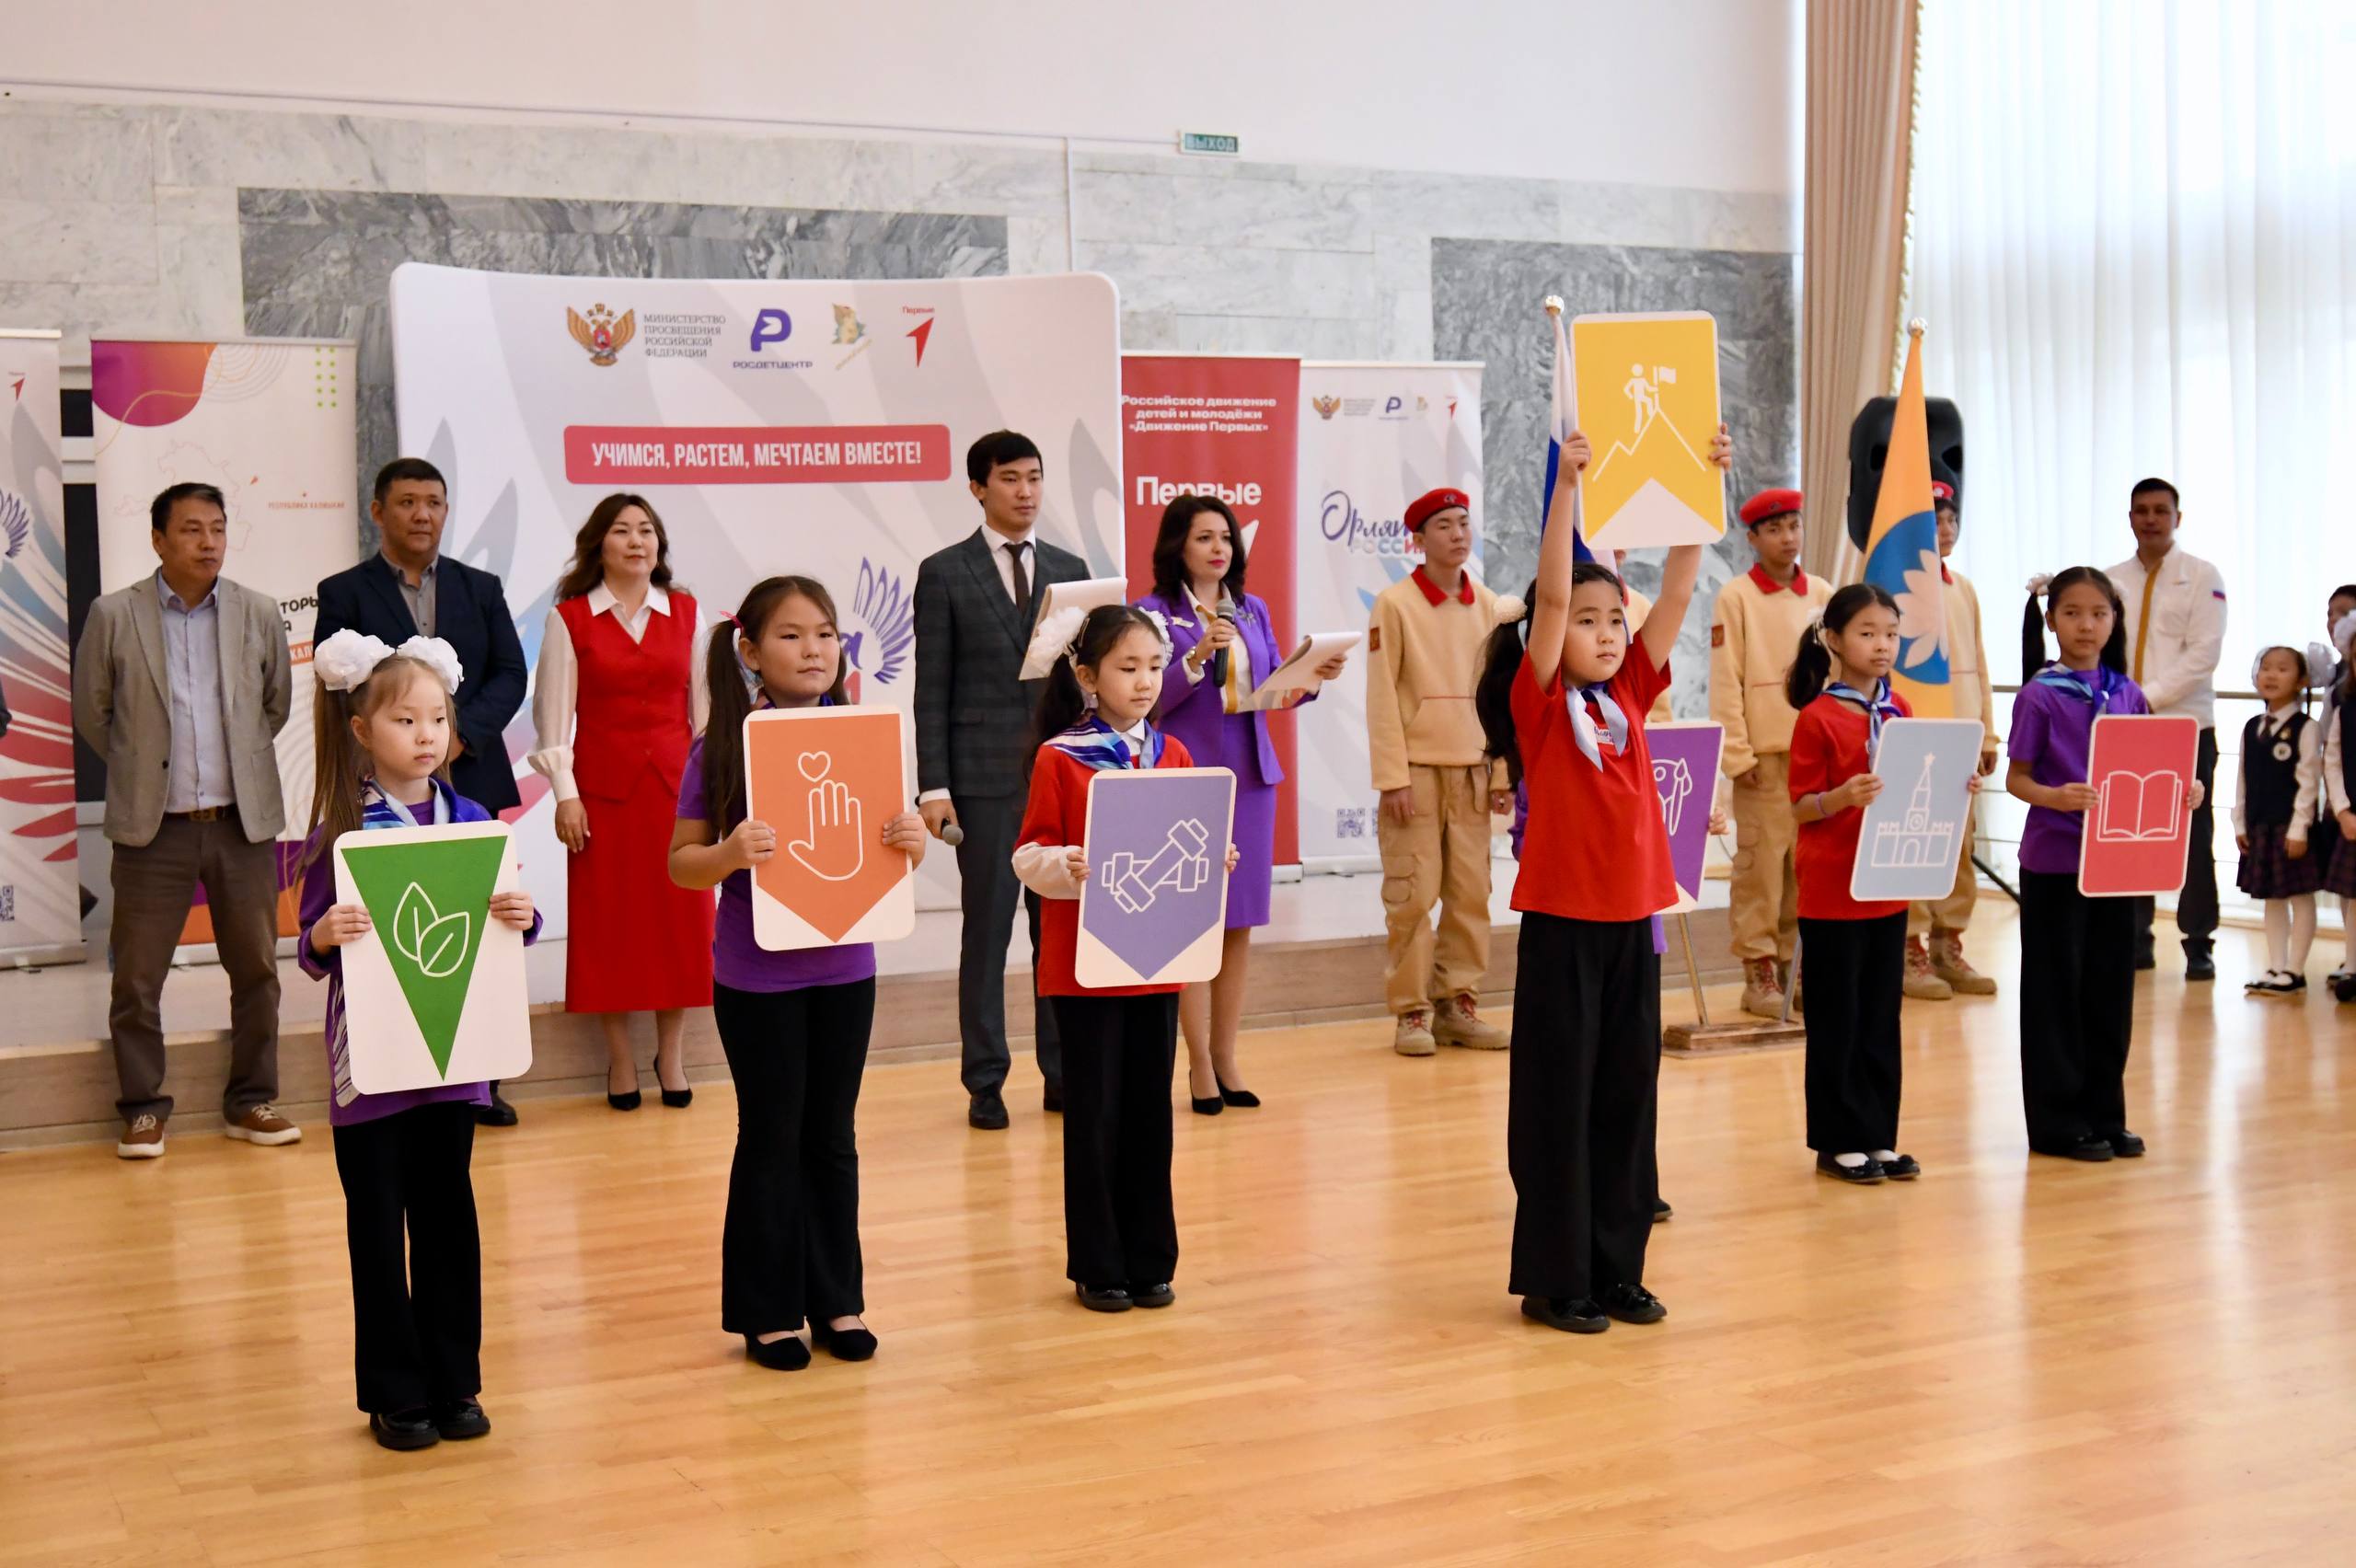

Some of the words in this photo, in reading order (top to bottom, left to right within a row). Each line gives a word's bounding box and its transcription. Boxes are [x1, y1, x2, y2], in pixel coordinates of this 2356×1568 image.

[1186, 134, 1235, 152] ВЫХОД
[644, 314, 726, 324] МИНИСТЕРСТВО
[644, 325, 722, 336] ПРОСВЕЩЕНИЯ
[645, 336, 712, 347] РОССИЙСКОЙ
[645, 348, 707, 358] ФЕДЕРАЦИИ
[733, 360, 813, 369] РОСДЕТЦЕНТР
[1121, 395, 1205, 407] Российское
[1206, 397, 1276, 408] движение
[1135, 409, 1177, 420] детей
[1179, 410, 1189, 419] и
[1191, 409, 1263, 421] молодёжи
[1128, 421, 1207, 432] «Движение
[1208, 421, 1268, 433] Первых»
[592, 443, 671, 469] УЧИМСЯ,
[675, 443, 750, 469] РАСТЕМ,
[754, 442, 840, 467] МЕЧТАЕМ
[844, 441, 921, 465] ВМЕСТЕ!
[1136, 476, 1263, 506] Первые
